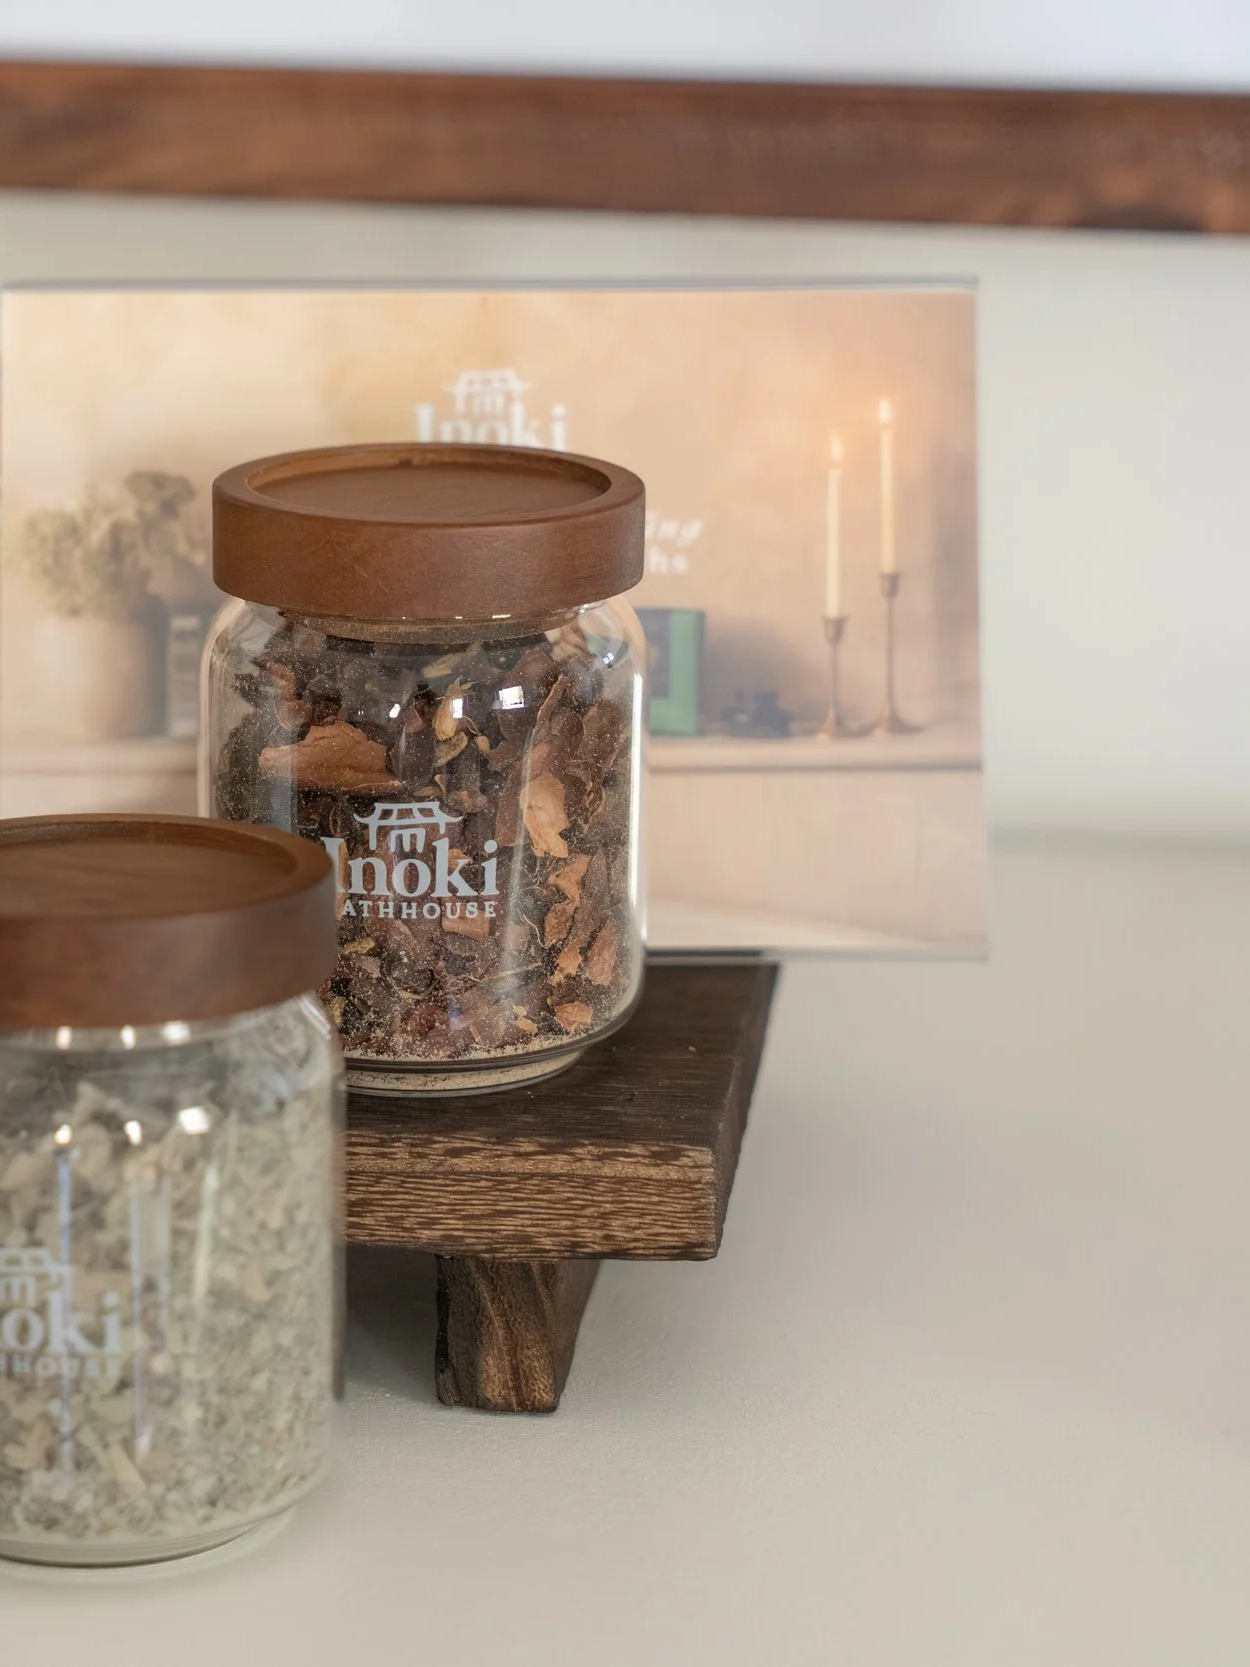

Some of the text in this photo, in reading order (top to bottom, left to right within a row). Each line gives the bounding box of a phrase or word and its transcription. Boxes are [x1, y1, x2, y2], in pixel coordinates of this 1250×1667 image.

[415, 402, 568, 452] Inoki
[320, 836, 500, 897] Inoki
[342, 900, 498, 920] ATHHOUSE
